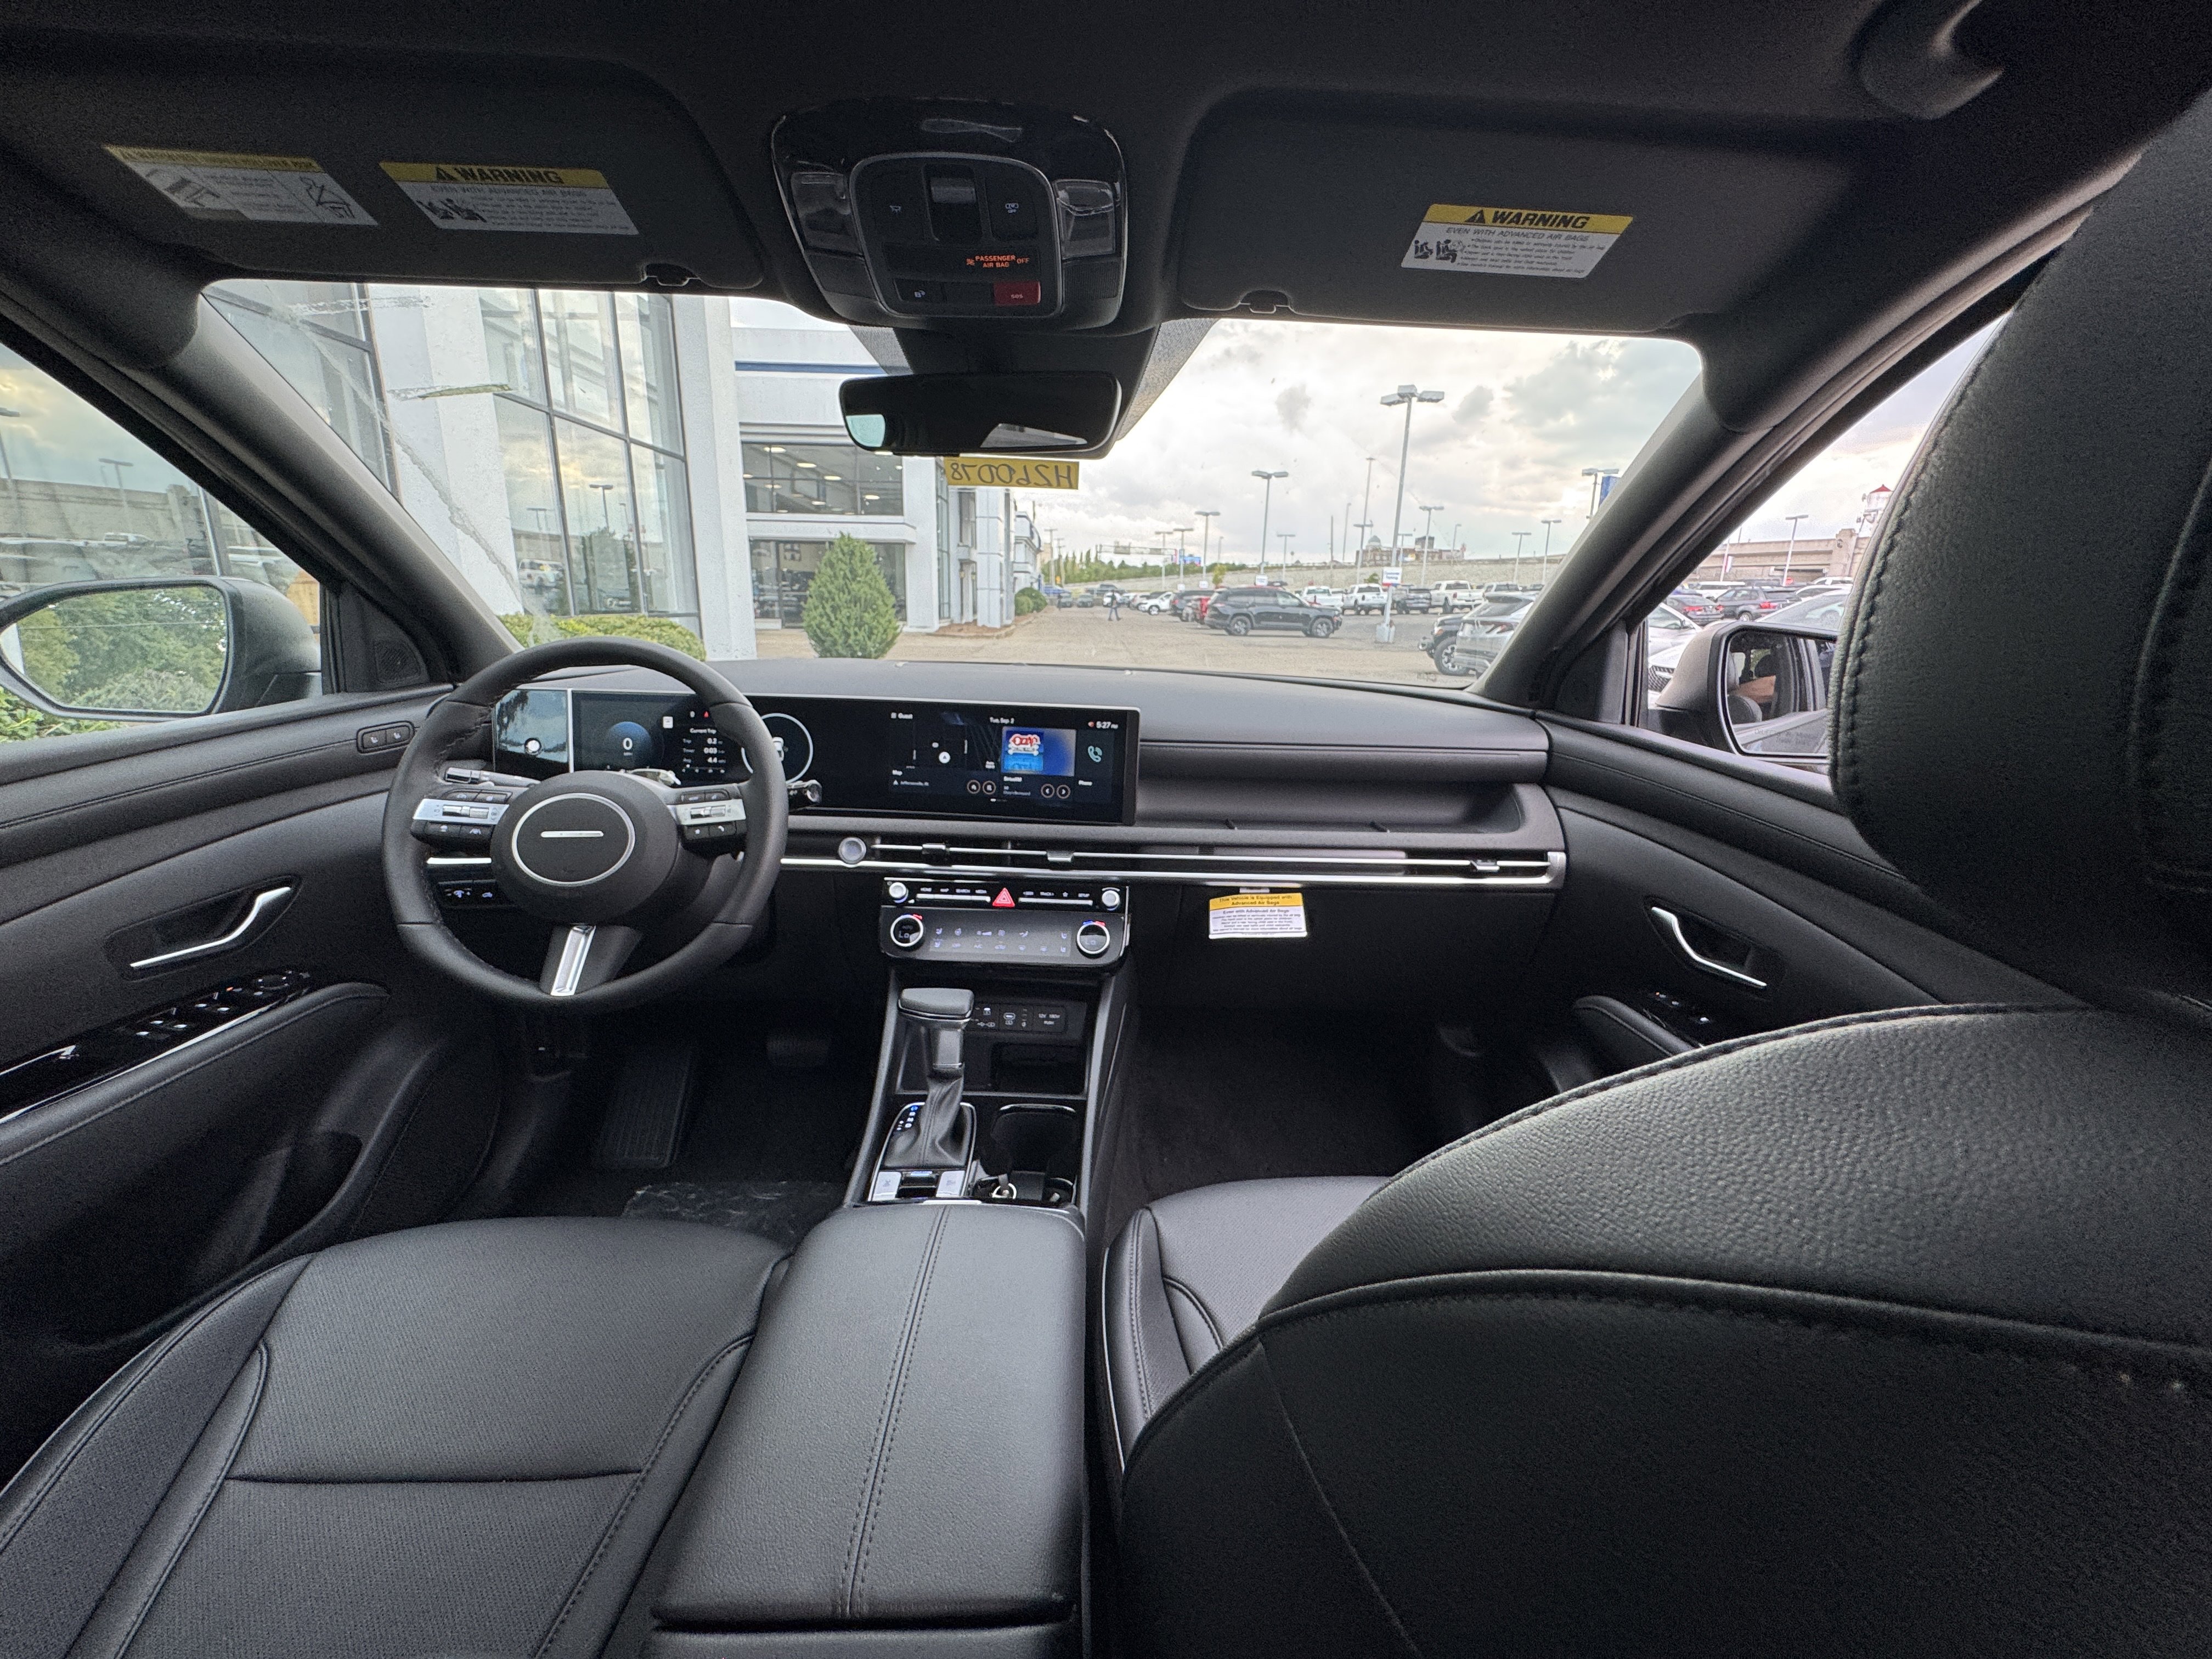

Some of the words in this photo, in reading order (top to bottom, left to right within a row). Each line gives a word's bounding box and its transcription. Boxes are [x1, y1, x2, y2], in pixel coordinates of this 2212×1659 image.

[454, 167, 565, 184] WARNING
[1491, 210, 1590, 229] WARNING
[1445, 227, 1470, 235] EVEN
[1472, 228, 1496, 236] WITH
[1498, 230, 1545, 240] ADVANCED
[1564, 234, 1589, 242] BAGS
[623, 737, 633, 750] 0
